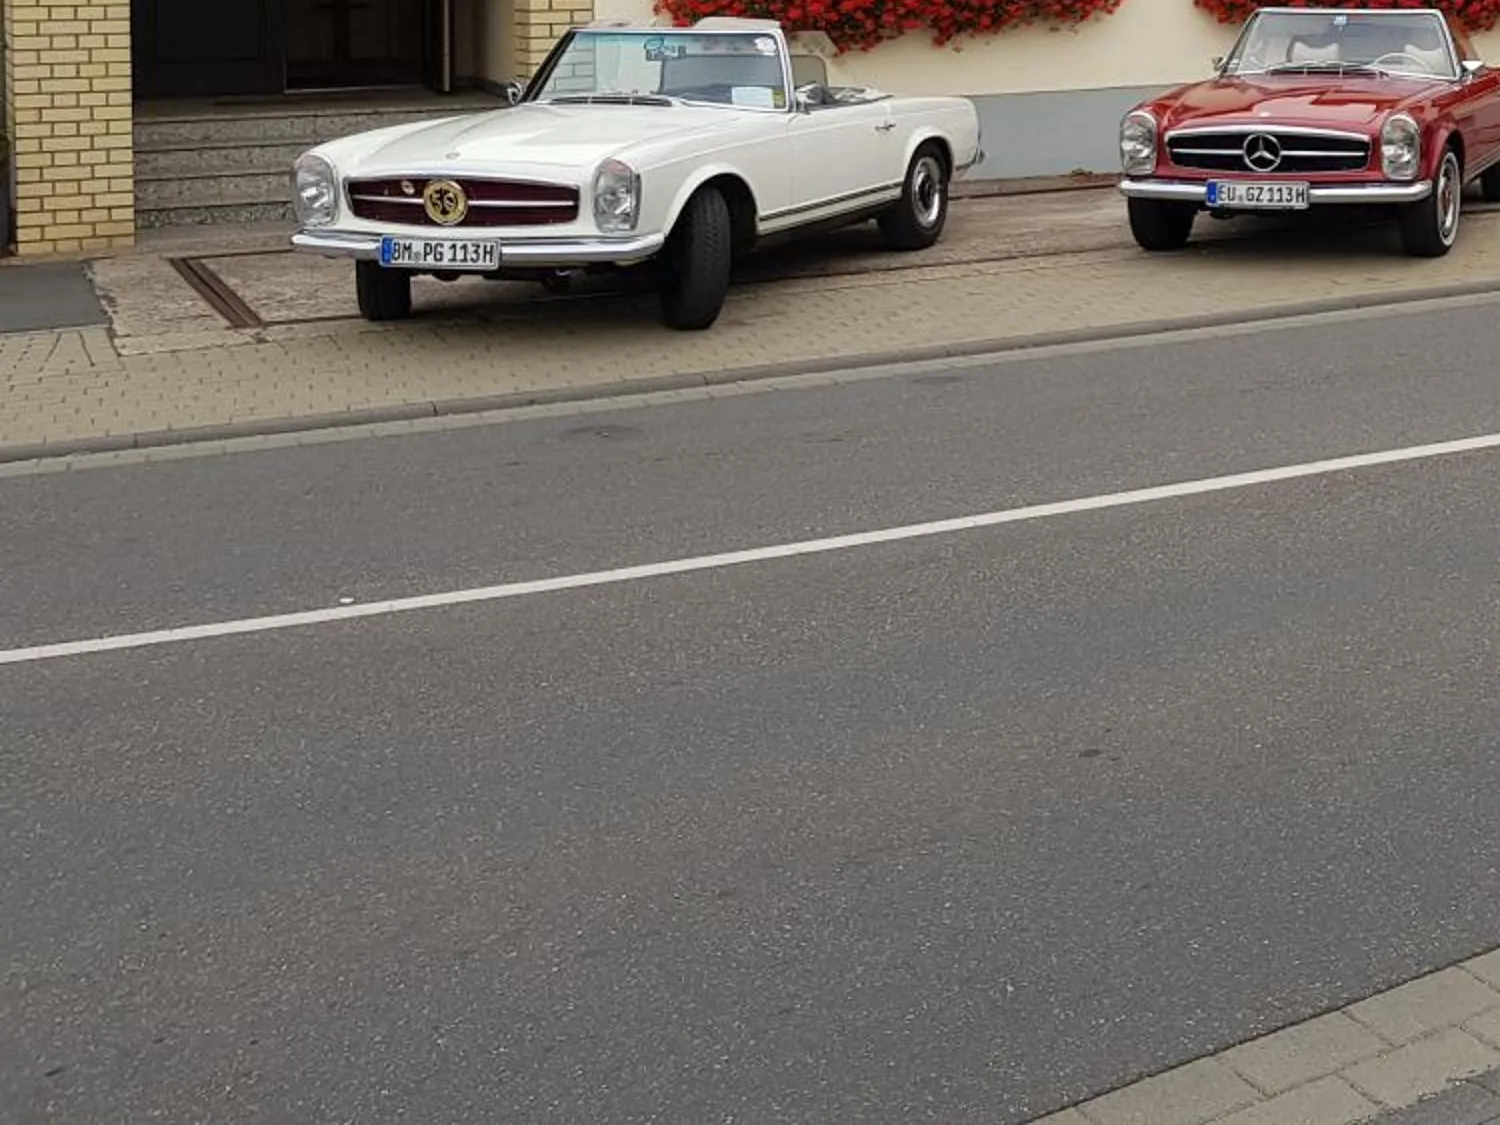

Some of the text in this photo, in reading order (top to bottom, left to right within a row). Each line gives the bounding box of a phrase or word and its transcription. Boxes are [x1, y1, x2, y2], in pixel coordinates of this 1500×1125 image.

[392, 242, 494, 263] BM PG 113H
